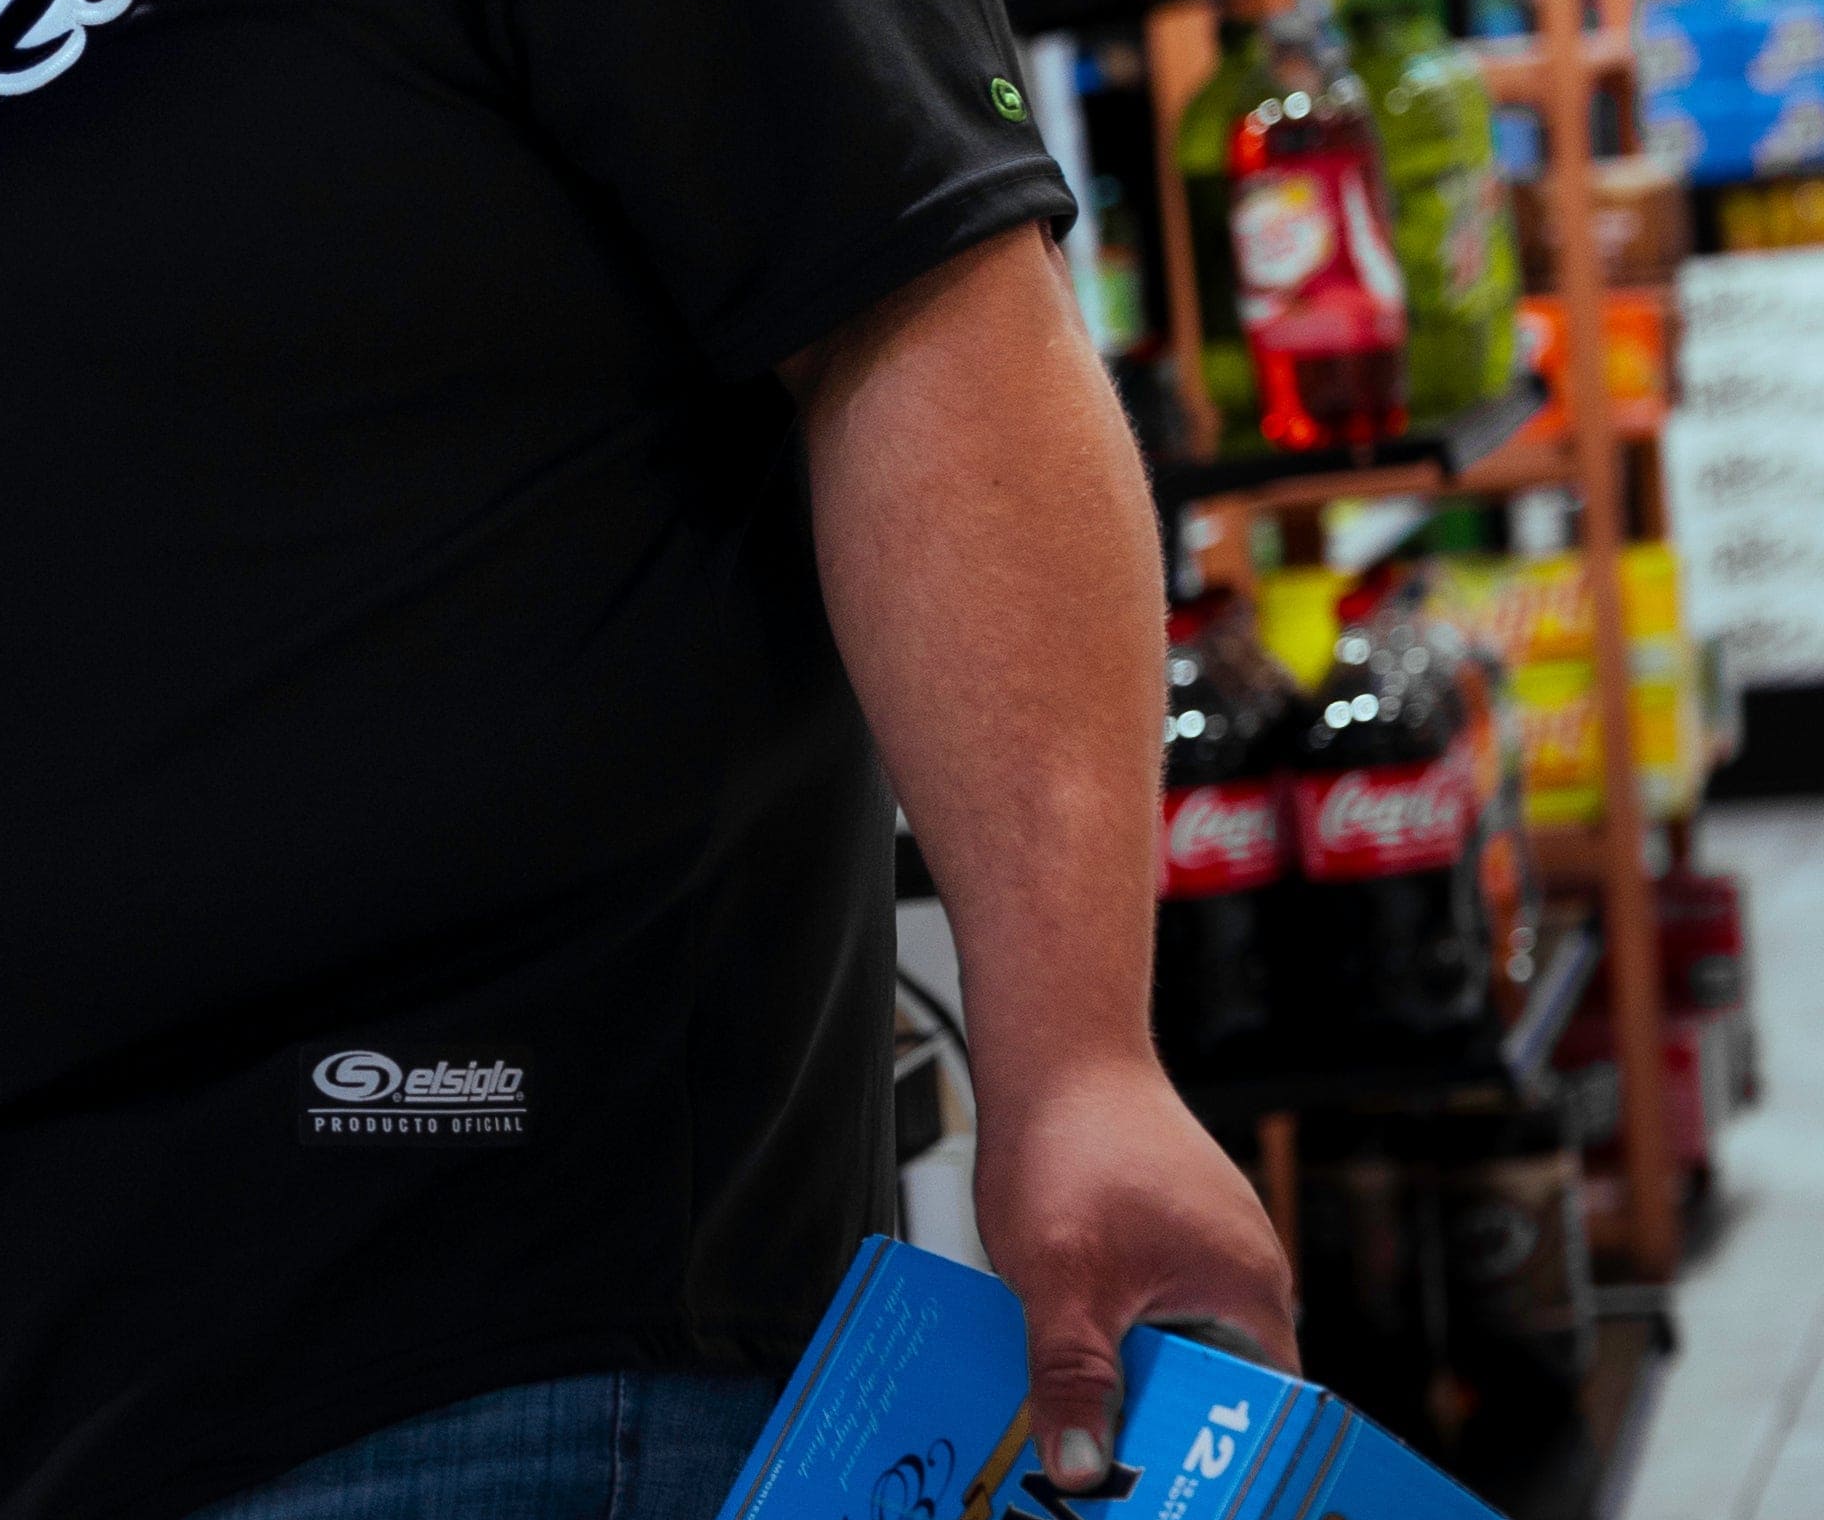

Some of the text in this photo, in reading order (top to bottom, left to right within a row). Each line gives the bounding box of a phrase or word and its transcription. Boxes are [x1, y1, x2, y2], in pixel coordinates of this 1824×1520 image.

[315, 1117, 523, 1133] PRODUCTO OFICIAL
[1182, 1401, 1251, 1476] 12
